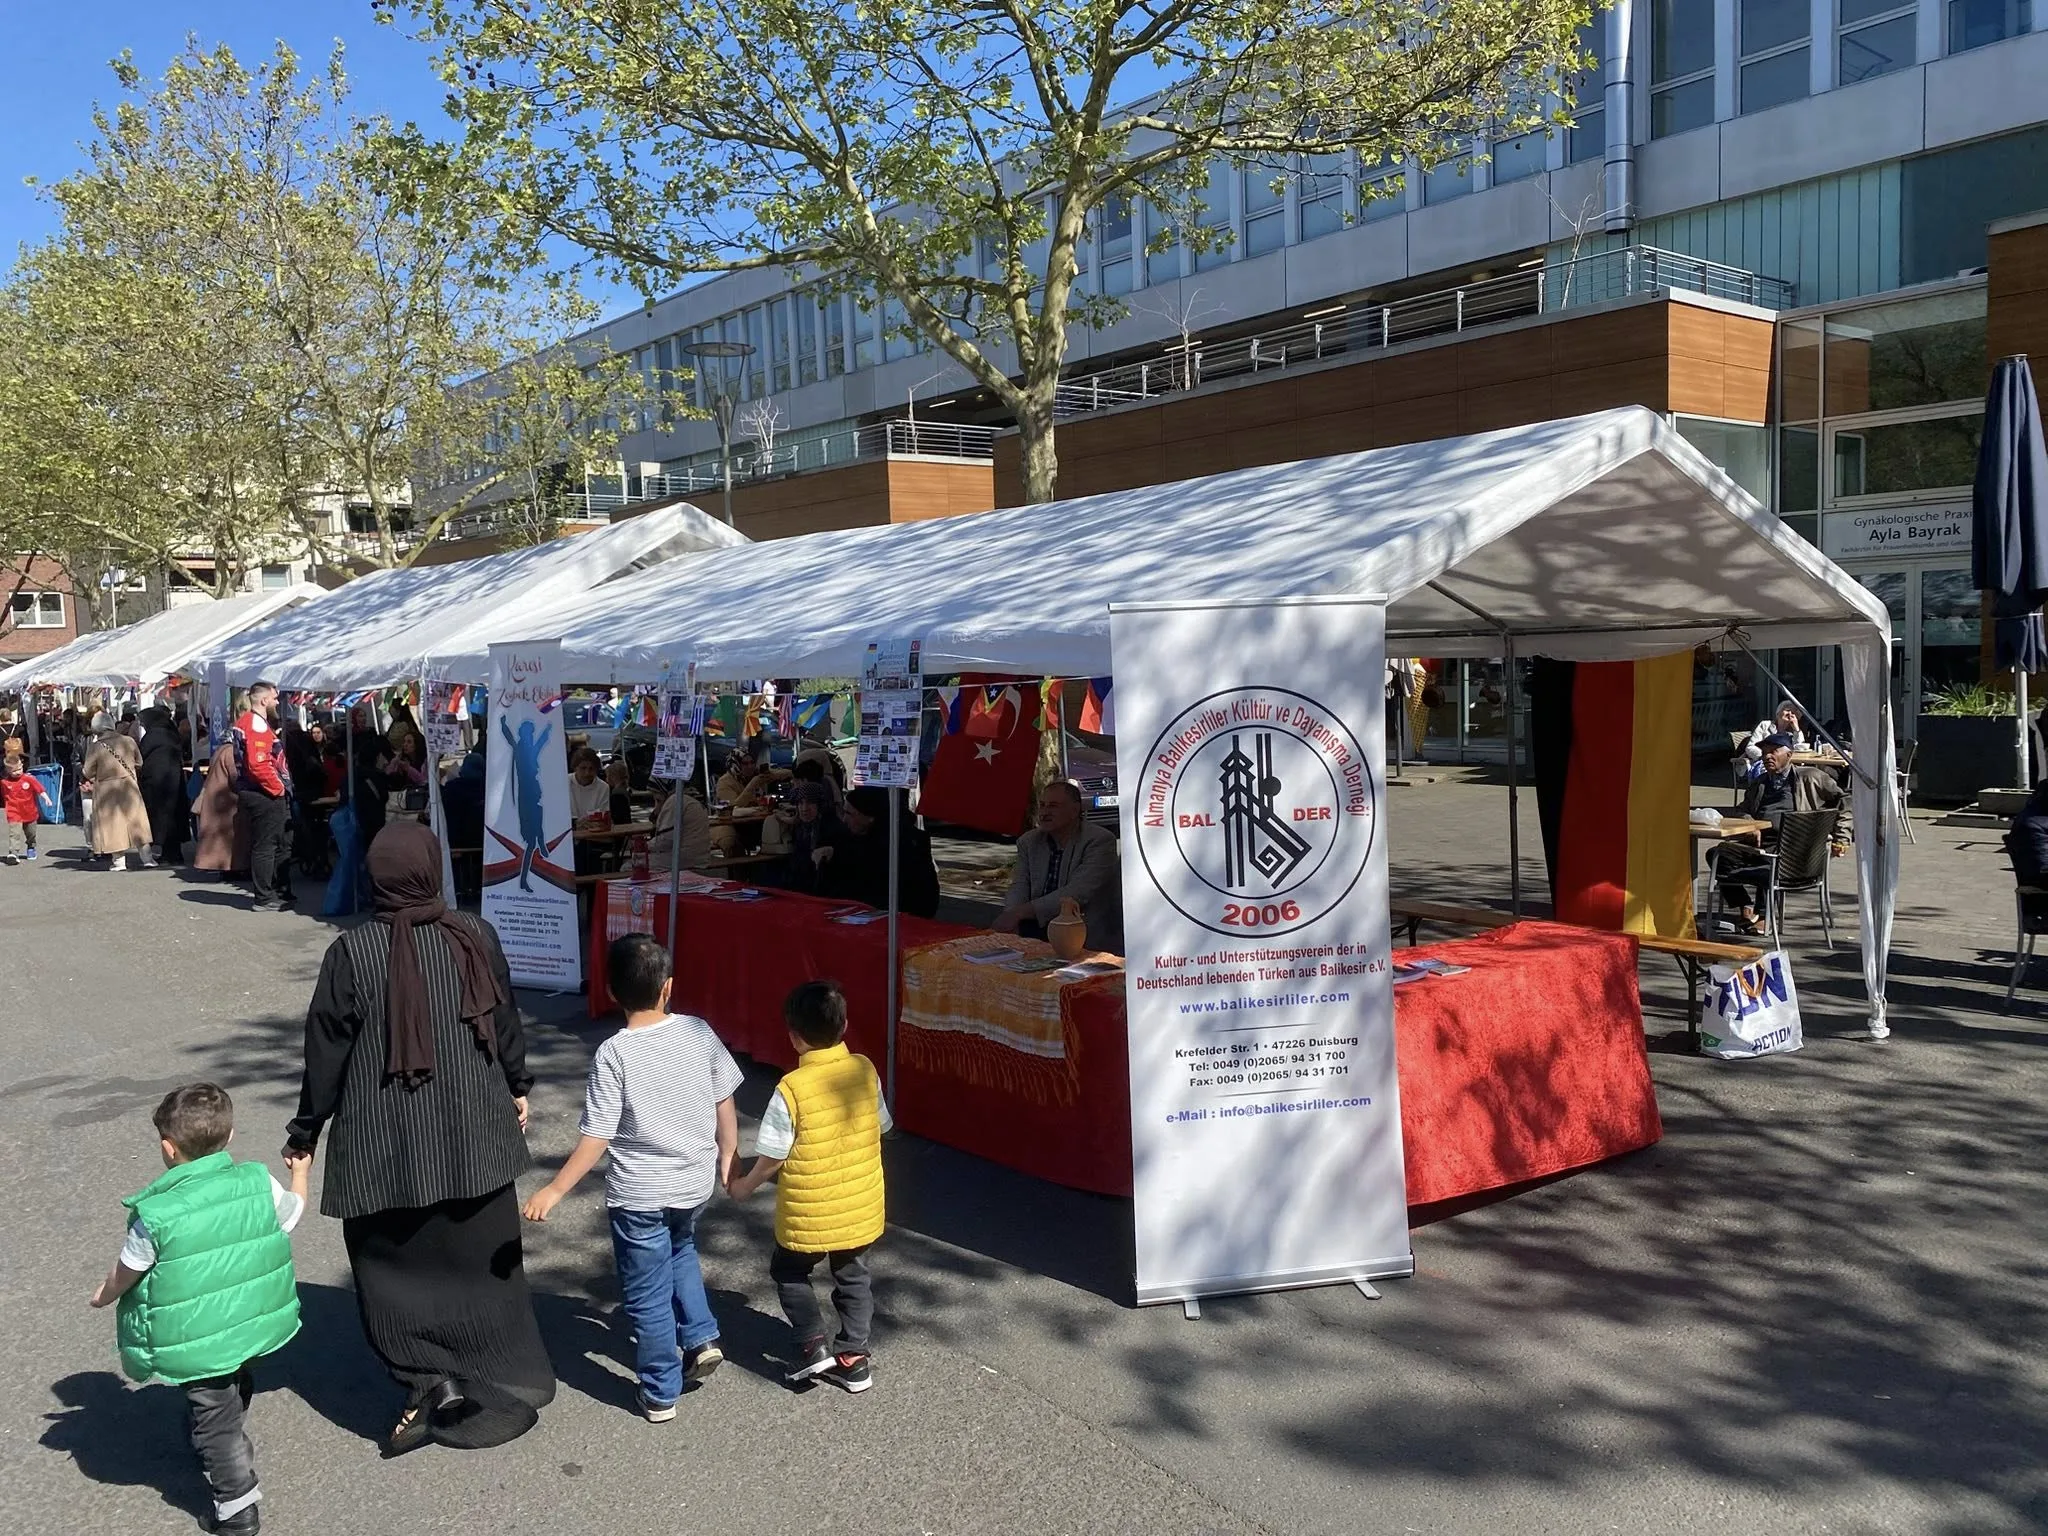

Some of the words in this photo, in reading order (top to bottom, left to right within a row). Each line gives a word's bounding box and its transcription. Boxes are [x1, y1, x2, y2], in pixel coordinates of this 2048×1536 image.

[1854, 512, 1939, 528] Gynäkologische
[1944, 510, 1972, 520] Praxi
[1869, 528, 1901, 543] Ayla
[1908, 523, 1961, 540] Bayrak
[1144, 768, 1173, 827] Almanya
[1231, 698, 1272, 721] Kültür
[1276, 704, 1290, 723] ve
[1292, 705, 1351, 766] Dayanışma
[1342, 762, 1370, 817] Derneği
[1179, 813, 1216, 828] BAL
[1293, 807, 1332, 821] DER
[1220, 900, 1301, 927] 2006
[1155, 955, 1188, 969] Kultur
[1197, 952, 1216, 965] und
[1219, 944, 1334, 963] Unterstützungsverein
[1337, 943, 1354, 956] der
[1357, 941, 1367, 954] in
[1137, 973, 1203, 990] Deutschland
[1207, 969, 1255, 985] lebenden
[1258, 965, 1295, 980] Türken
[1298, 967, 1317, 978] aus
[1320, 961, 1367, 976] Balikesir
[1369, 959, 1386, 973] e.V.
[1180, 992, 1350, 1014] www.balikesirliler.com
[1175, 1046, 1227, 1058] Krefelder
[1230, 1044, 1250, 1054] Str.
[1253, 1042, 1259, 1051] 1
[1271, 1039, 1306, 1050] 47226
[1309, 1036, 1358, 1047] Duisburg
[1189, 1062, 1210, 1072] Tel:
[1213, 1059, 1240, 1070] 0049
[1291, 1054, 1305, 1063] 94
[1308, 1053, 1321, 1062] 31
[1325, 1051, 1346, 1060] 700
[1190, 1078, 1213, 1087] Fax:
[1217, 1074, 1244, 1085] 0049
[1295, 1069, 1309, 1078] 94
[1312, 1067, 1325, 1076] 31
[1329, 1066, 1349, 1075] 701
[1166, 1109, 1207, 1122] e-Mail
[1220, 1097, 1371, 1117] info@balikesirliler.com
